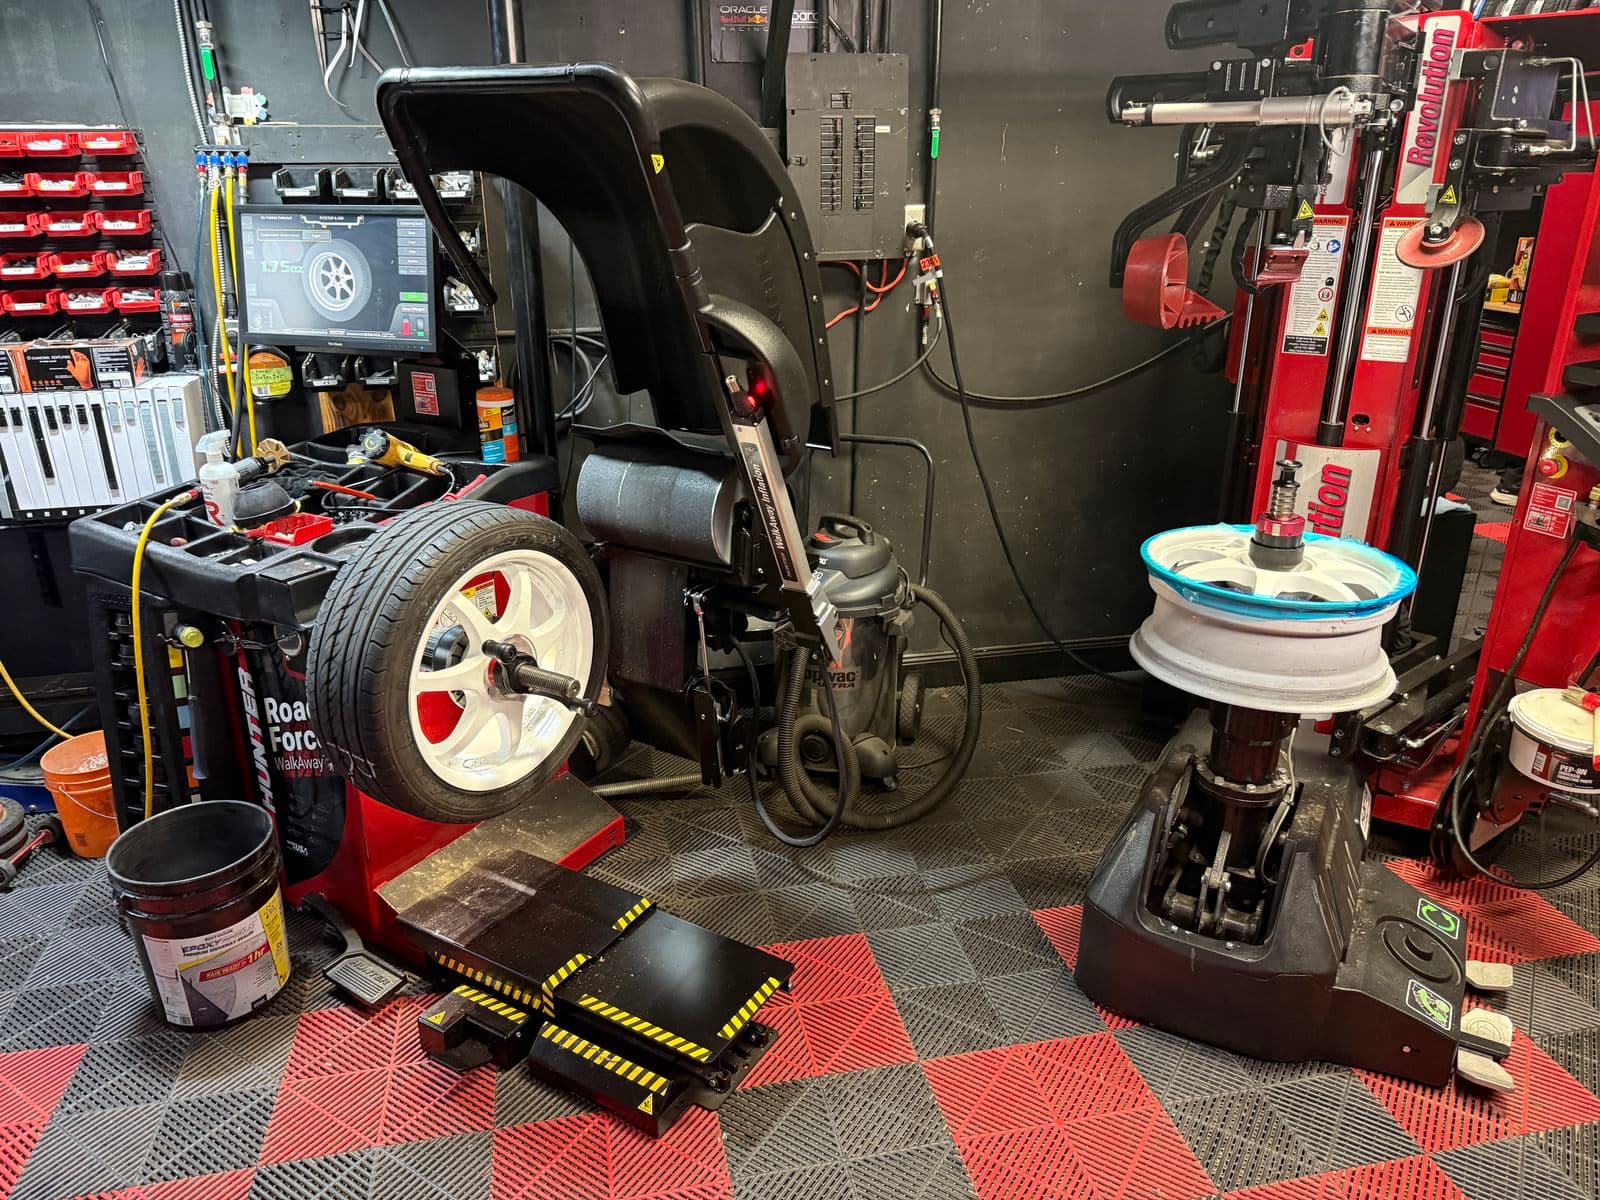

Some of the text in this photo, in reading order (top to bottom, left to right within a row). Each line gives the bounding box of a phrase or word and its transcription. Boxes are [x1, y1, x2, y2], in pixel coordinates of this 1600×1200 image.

[719, 5, 768, 14] ORACLE
[791, 11, 819, 25] parc
[1407, 28, 1455, 167] Revolution
[1396, 220, 1420, 228] WARN
[1377, 328, 1409, 336] WARNING
[756, 463, 771, 504] Inflation
[766, 500, 786, 550] WalkAway
[264, 697, 311, 724] Roa
[237, 666, 277, 814] HUNTER
[269, 726, 321, 753] Forc
[274, 756, 324, 773] WalkAway
[181, 939, 222, 954] EPOXY
